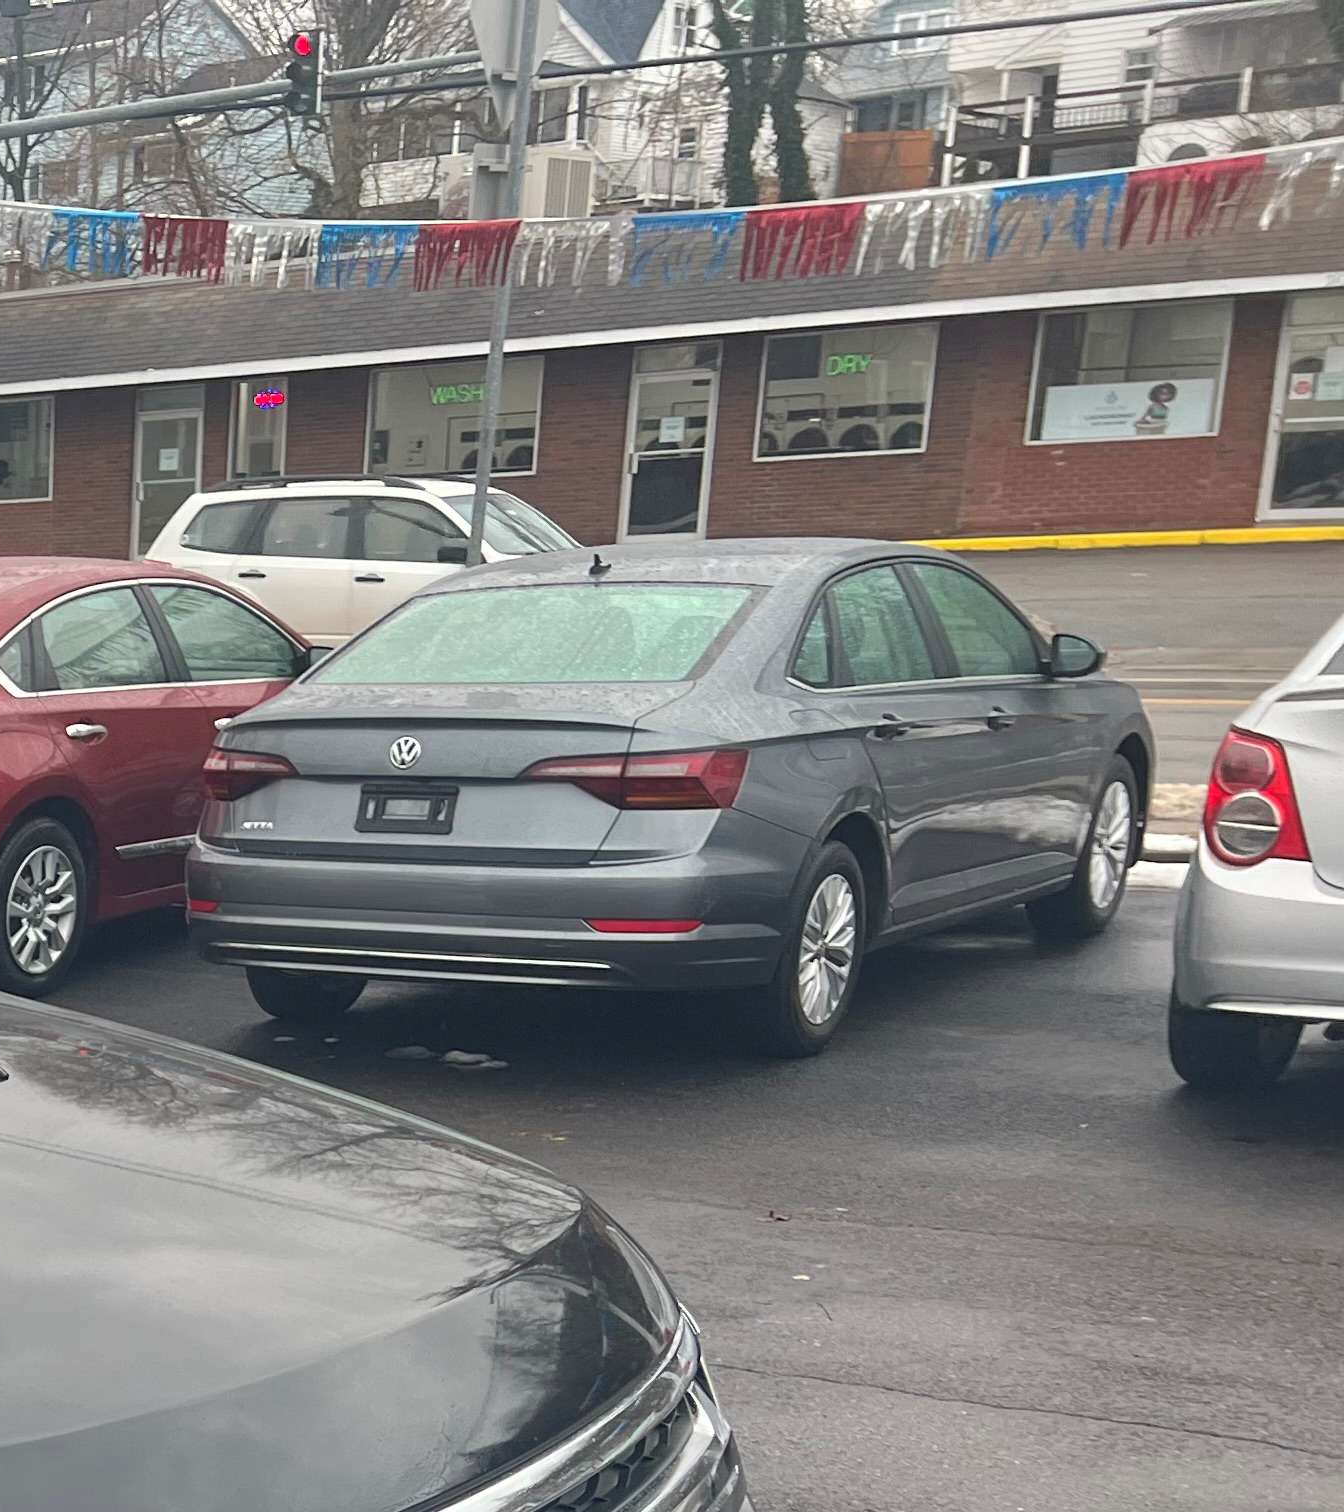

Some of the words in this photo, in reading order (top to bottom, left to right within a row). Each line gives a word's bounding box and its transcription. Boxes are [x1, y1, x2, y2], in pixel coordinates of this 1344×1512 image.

[826, 354, 873, 376] DRY
[430, 383, 485, 405] WASH
[390, 736, 422, 769] VW
